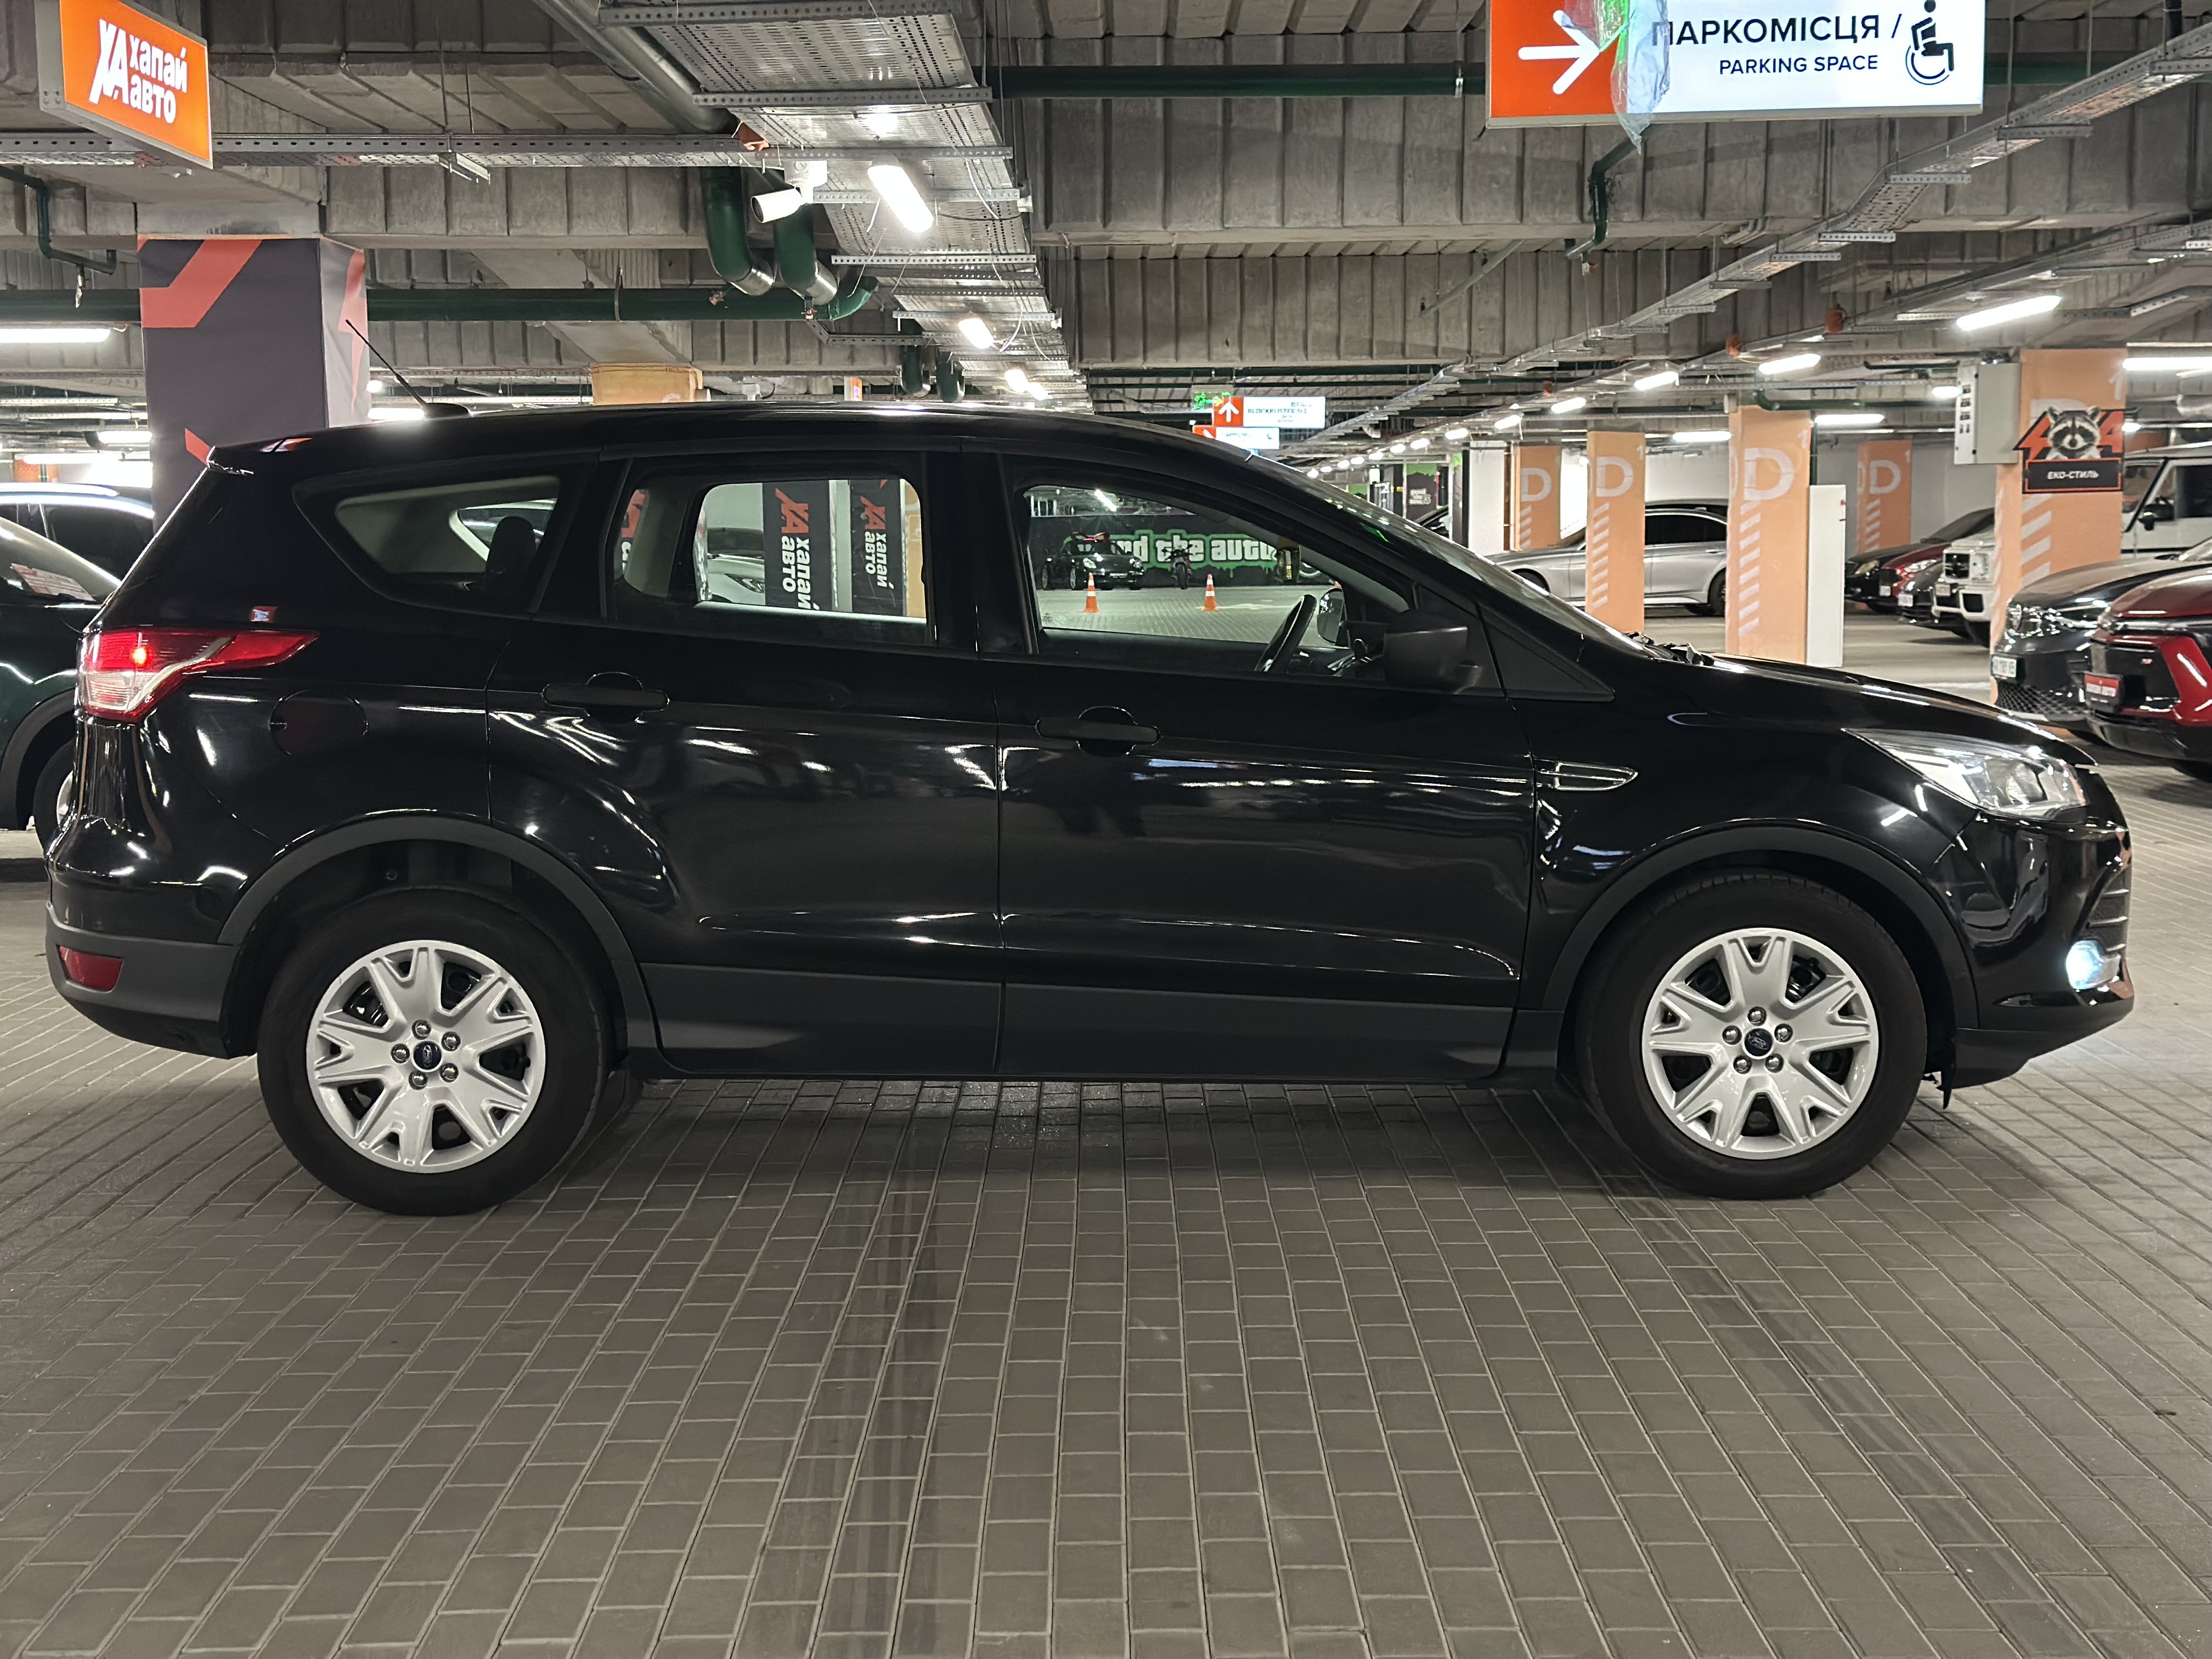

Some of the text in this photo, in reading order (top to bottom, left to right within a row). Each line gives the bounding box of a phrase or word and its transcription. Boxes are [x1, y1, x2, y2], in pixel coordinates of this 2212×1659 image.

[1652, 15, 1880, 46] ПАРКОМІСЦЯ
[129, 34, 188, 93] хапай
[1719, 55, 1878, 75] PARKING SPACE
[130, 74, 177, 124] авто
[1521, 467, 1552, 502] D
[1596, 456, 1634, 497] D
[1744, 448, 1795, 501] D
[1869, 459, 1901, 494] D
[2047, 470, 2099, 480] ЕКО-СТИЛЬ
[781, 535, 796, 593] авто
[796, 537, 820, 611] хапай
[865, 531, 876, 575] авто
[876, 532, 894, 590] хапай
